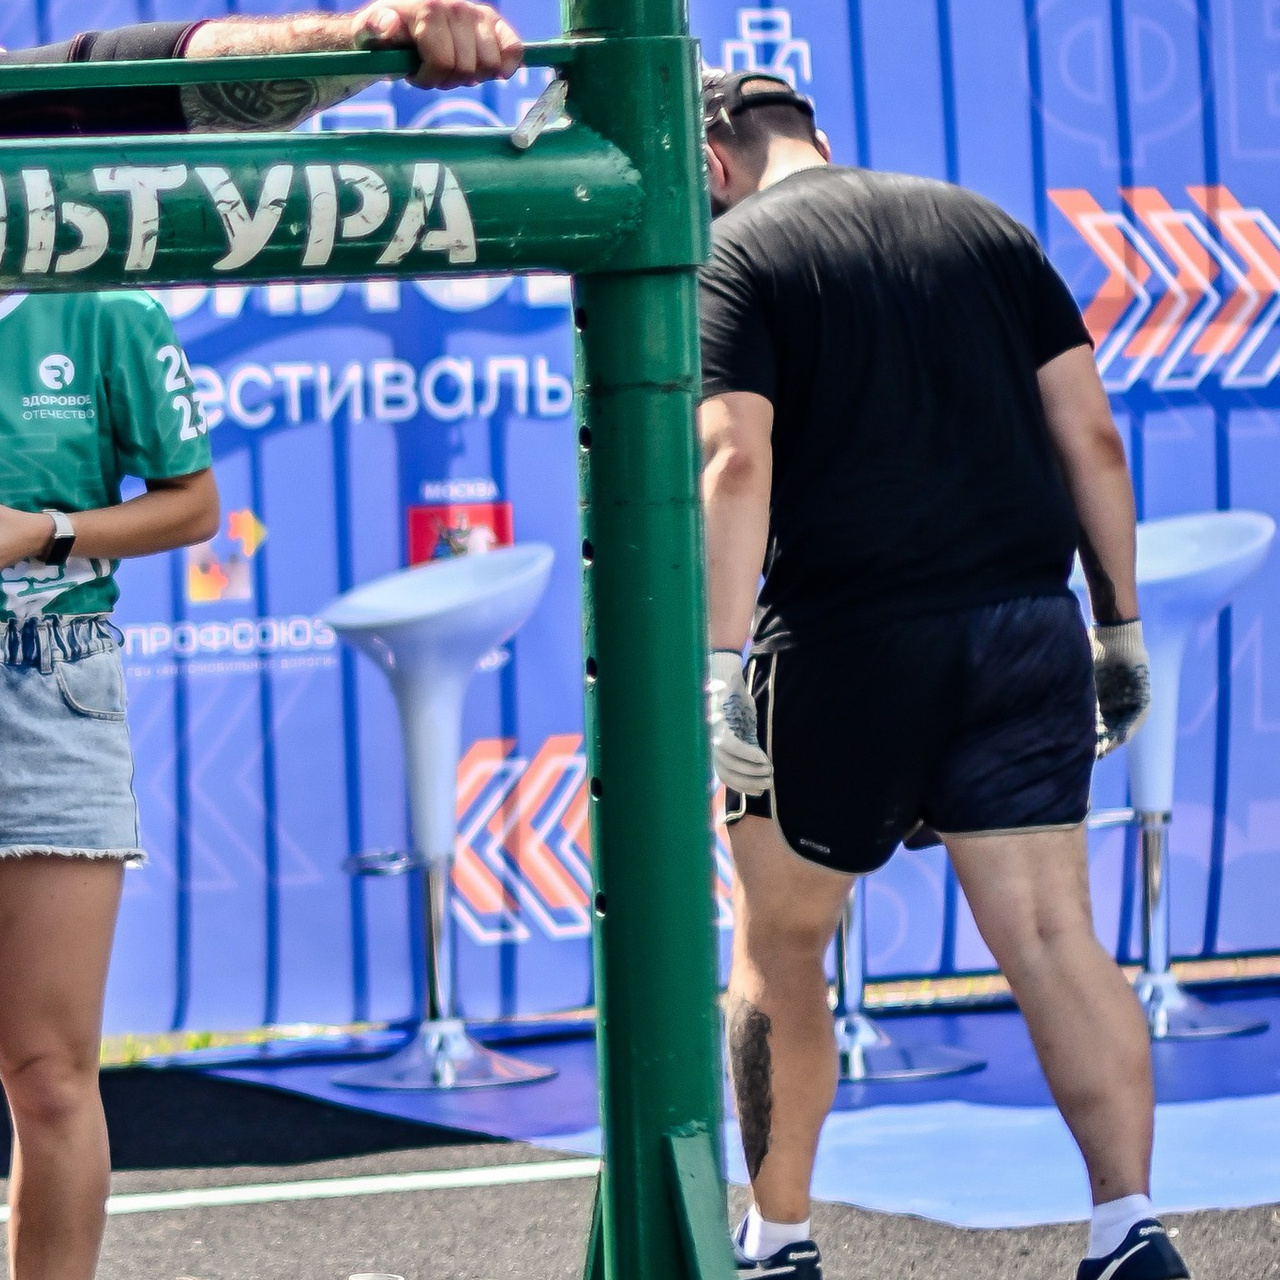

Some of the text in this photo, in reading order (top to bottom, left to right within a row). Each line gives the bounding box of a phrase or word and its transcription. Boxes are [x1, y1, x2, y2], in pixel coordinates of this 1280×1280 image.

[22, 394, 92, 407] ЗДОРОВОЕ
[190, 357, 573, 429] естиваль
[22, 408, 95, 421] ОТЕЧЕСТВО
[124, 619, 336, 656] ПРОФСОЮЗ
